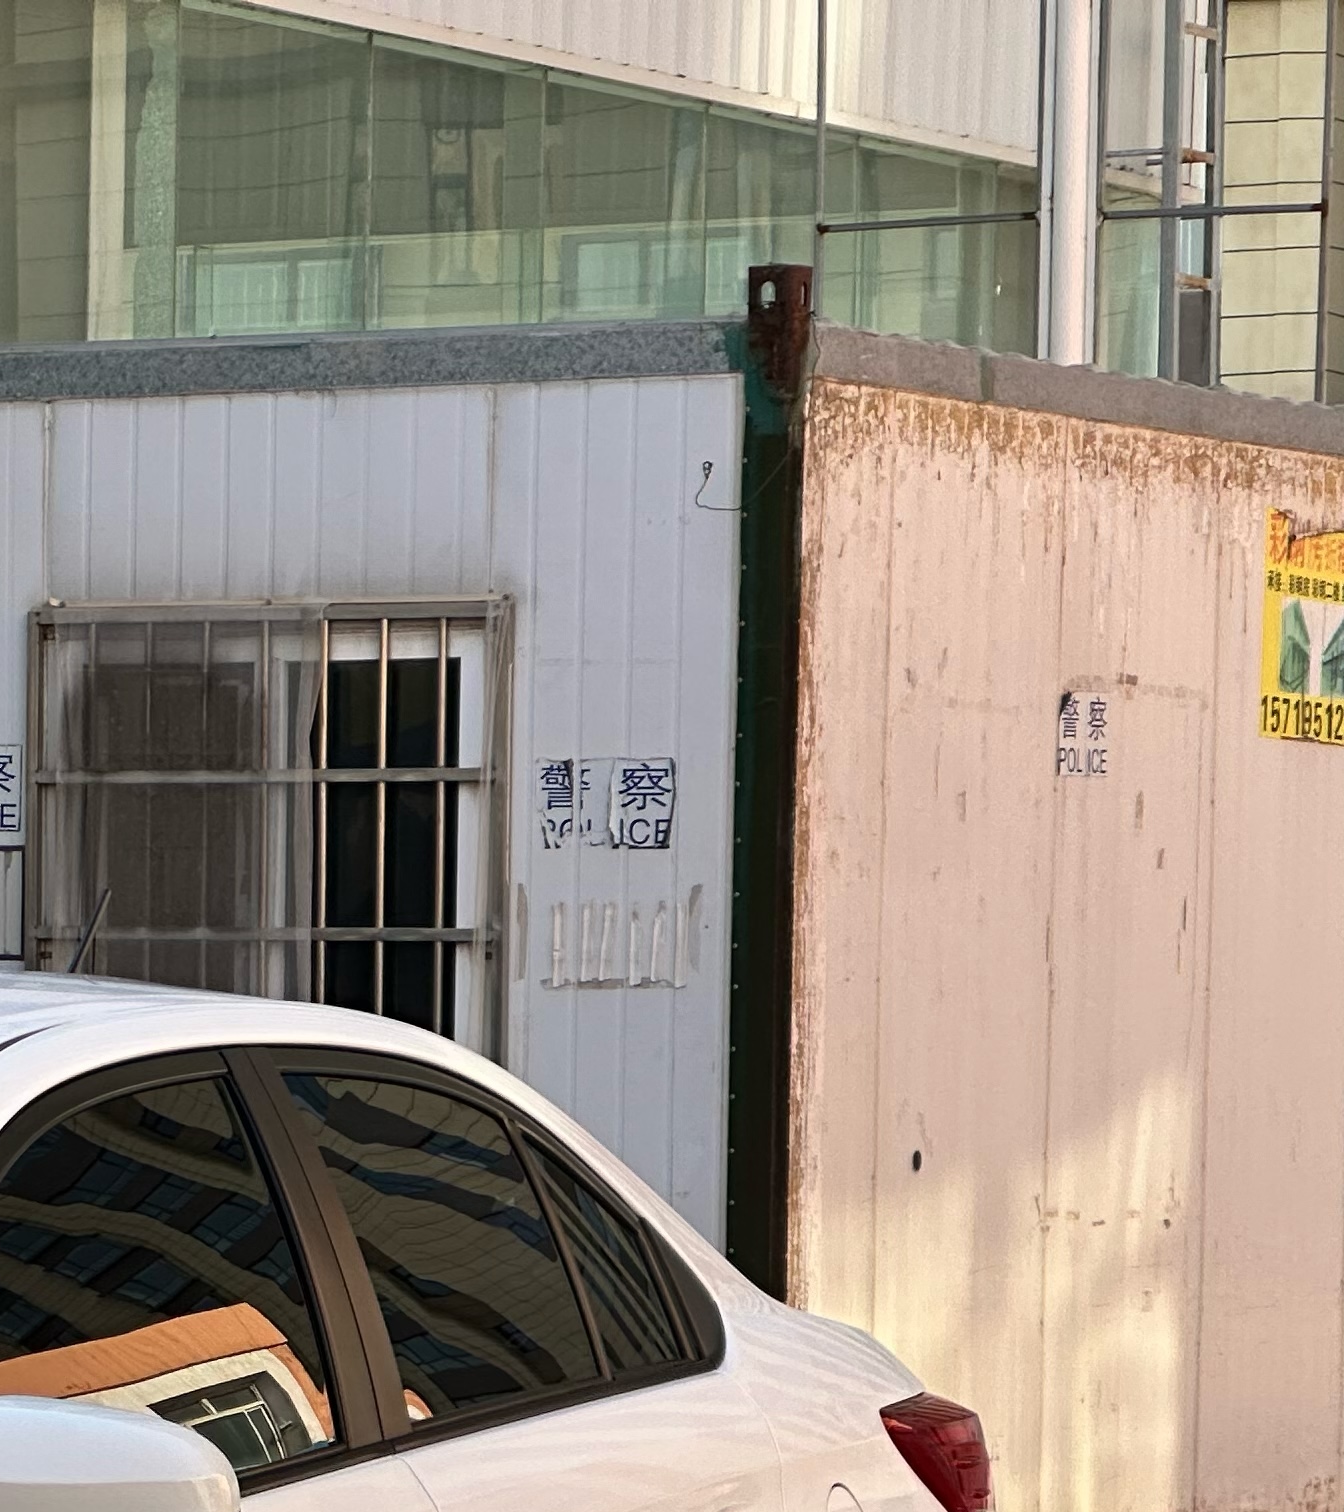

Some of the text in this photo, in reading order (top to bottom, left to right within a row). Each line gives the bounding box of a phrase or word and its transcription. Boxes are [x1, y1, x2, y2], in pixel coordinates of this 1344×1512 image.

[1061, 696, 1108, 741] 警察
[1057, 747, 1108, 774] POLICE
[541, 762, 673, 811] 警察
